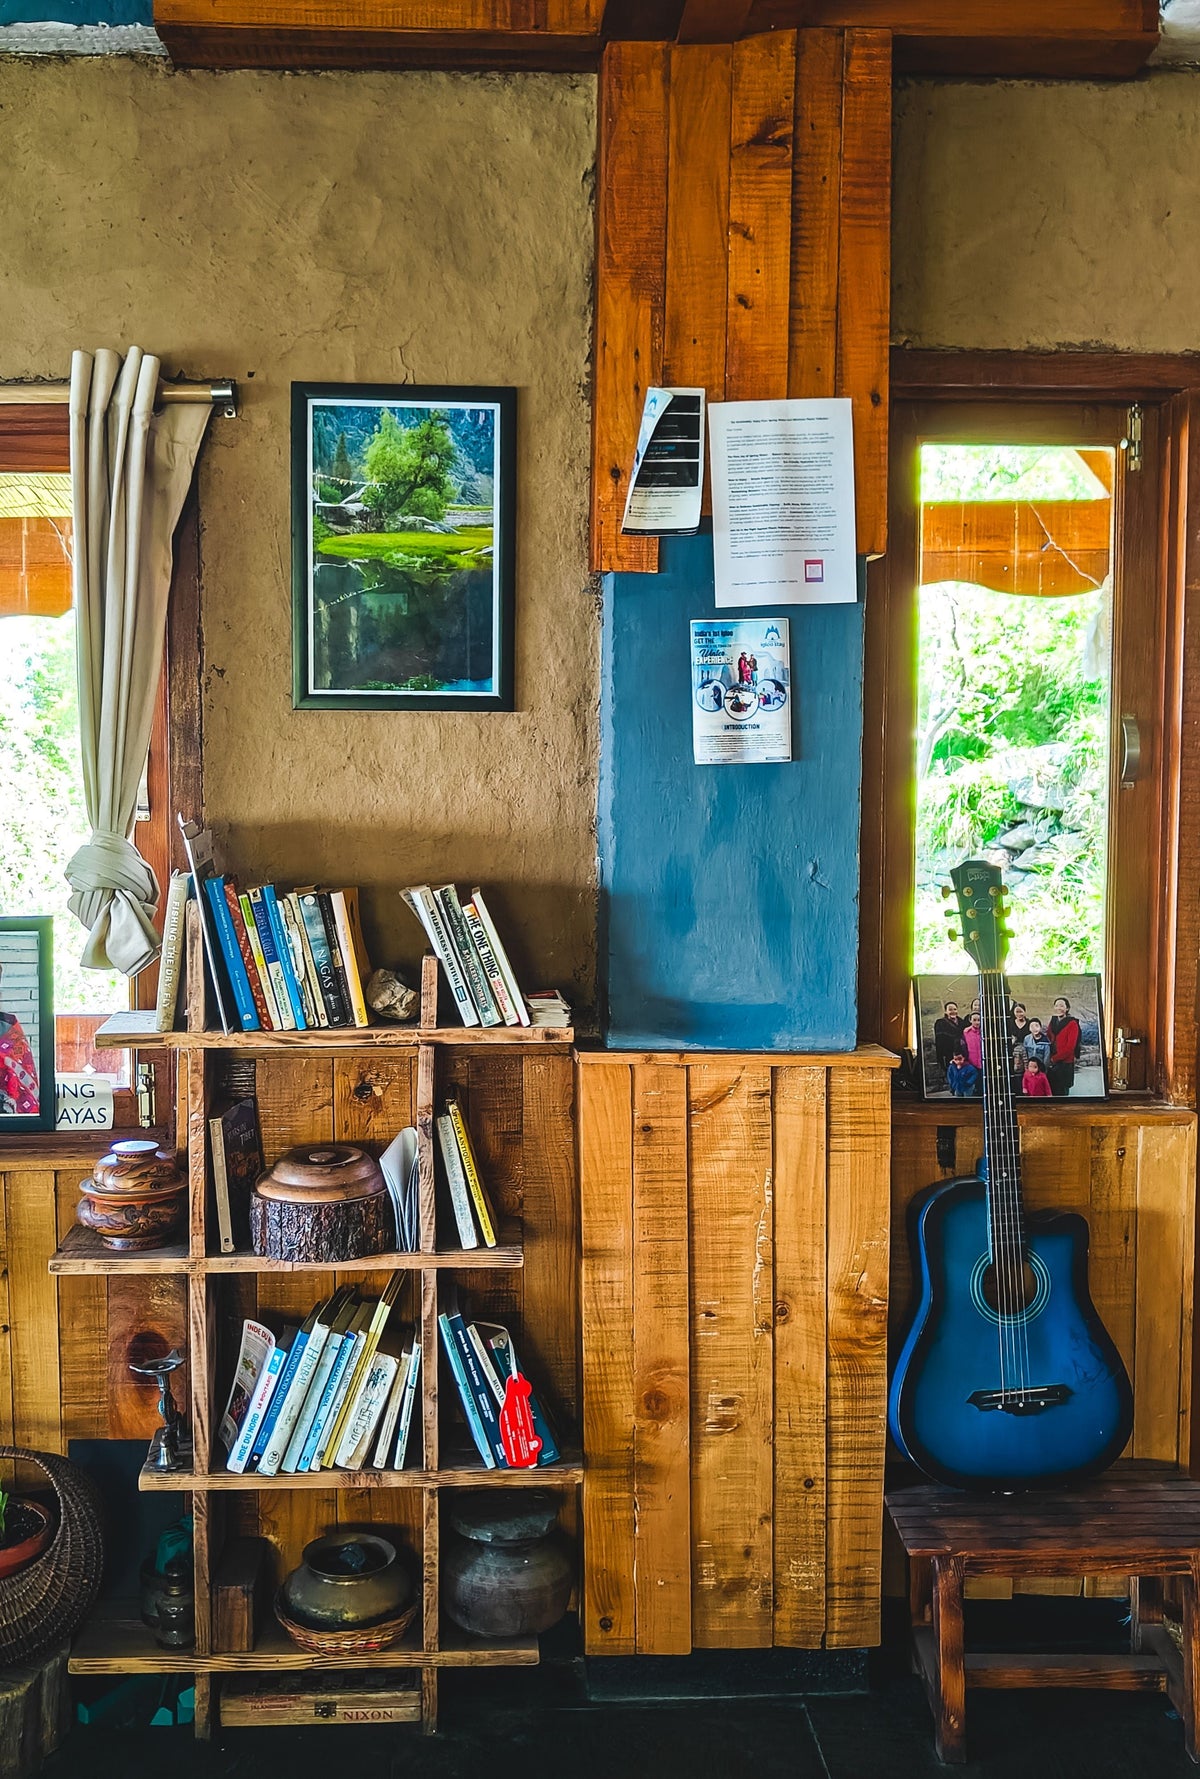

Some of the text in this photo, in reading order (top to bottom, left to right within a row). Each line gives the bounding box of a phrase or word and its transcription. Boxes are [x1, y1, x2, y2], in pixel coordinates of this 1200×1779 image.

[696, 656, 734, 666] EXPERIENCE
[162, 900, 180, 1008] FISHING THE DRY FLY
[426, 908, 451, 952] WILDERNESS
[442, 952, 462, 987] SURVIVAL
[465, 911, 500, 980] THE ONE THING
[315, 948, 333, 989] NAGAS
[461, 947, 481, 984] KATHLEEN
[473, 982, 489, 1008] NORRIS
[457, 1135, 475, 1177] ANTIQUITIES
[245, 1322, 262, 1335] INDE
[288, 1343, 303, 1370] BEYOND
[294, 1346, 319, 1388] HERBAL
[321, 1345, 348, 1407] COLD DESERTS OF INDIA
[259, 1374, 273, 1402] ROUTARD
[274, 1389, 285, 1405] AND
[280, 1369, 293, 1390] GOOD
[491, 1378, 506, 1401] ROAD
[236, 1412, 260, 1462] INDE DU NORD
[342, 1710, 394, 1720] NIXON
